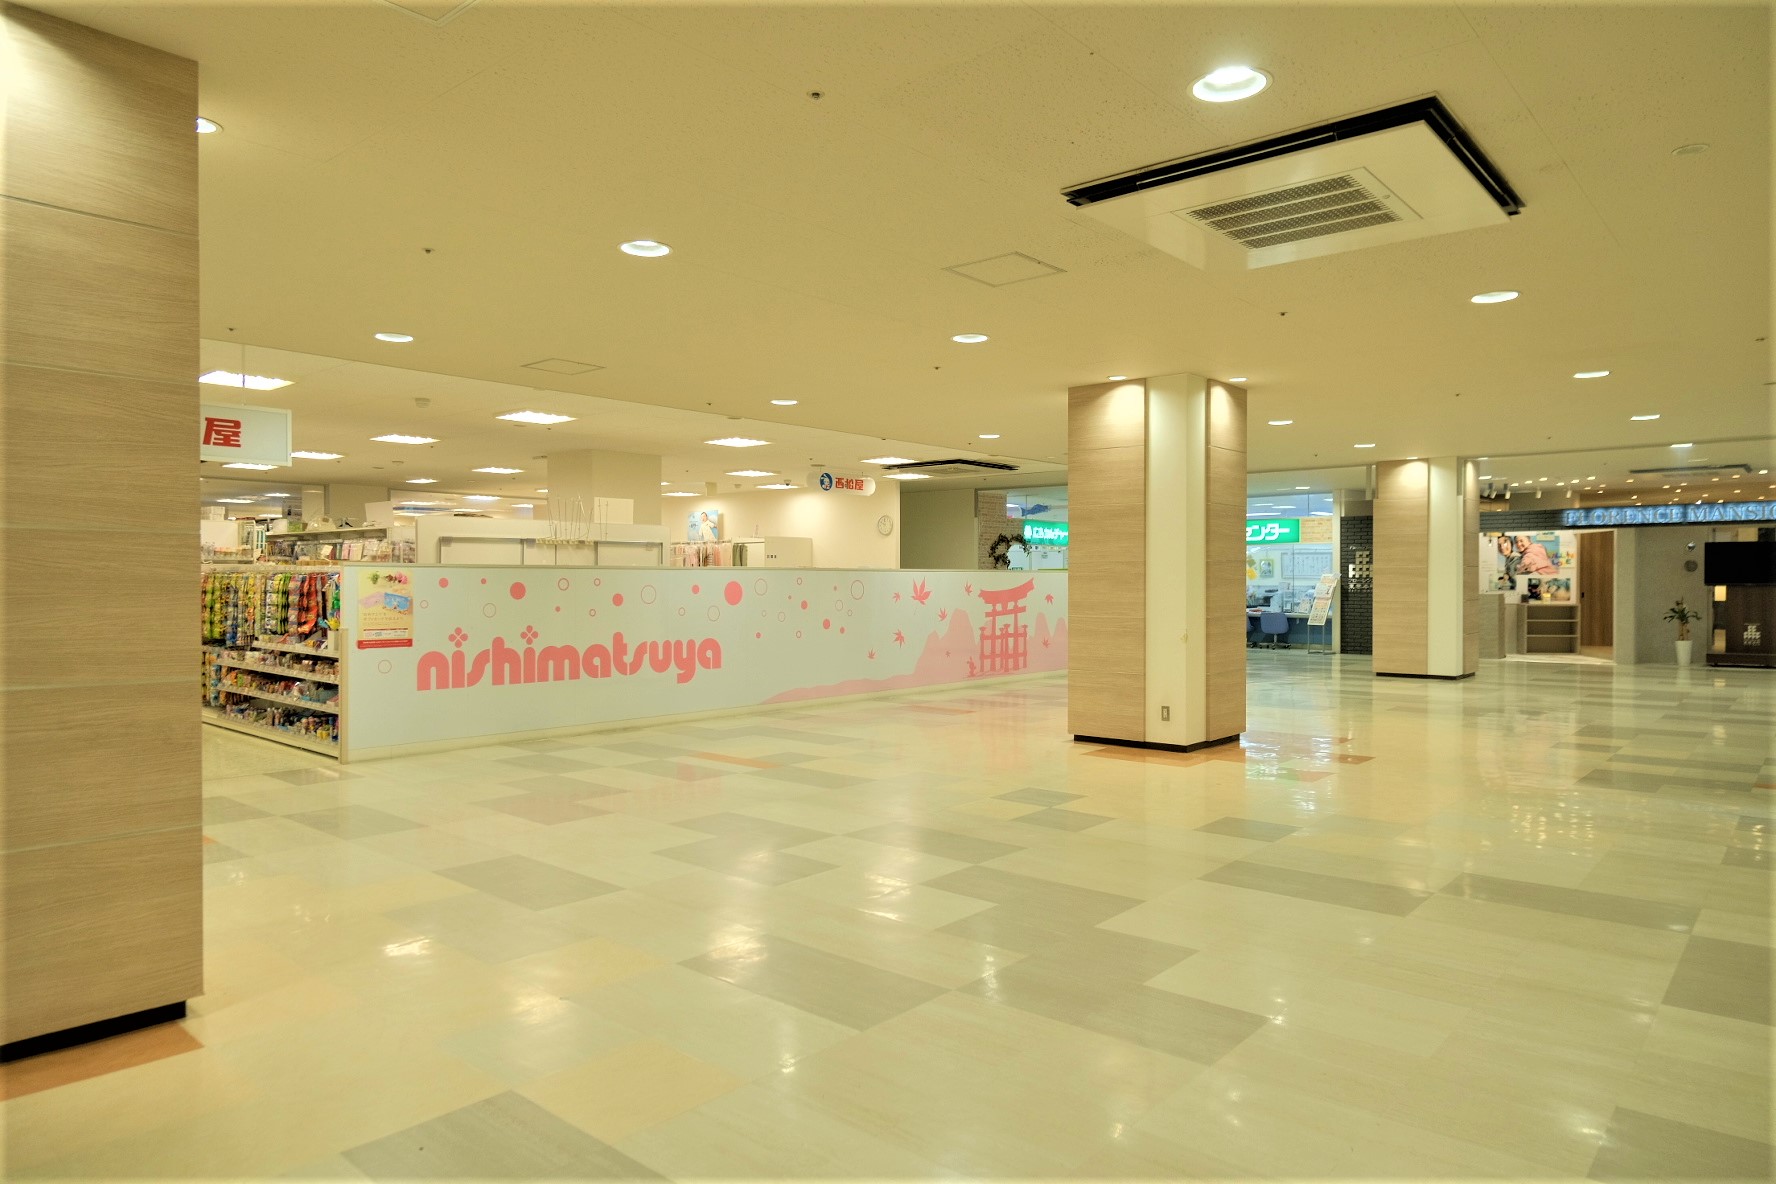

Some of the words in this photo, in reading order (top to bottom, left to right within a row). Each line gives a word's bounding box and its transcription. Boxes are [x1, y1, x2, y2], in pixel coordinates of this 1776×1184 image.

[202, 416, 242, 448] 屋
[835, 477, 864, 491] 西松屋
[1565, 506, 1683, 526] FLORENCE
[416, 626, 722, 692] nishimatsuya
